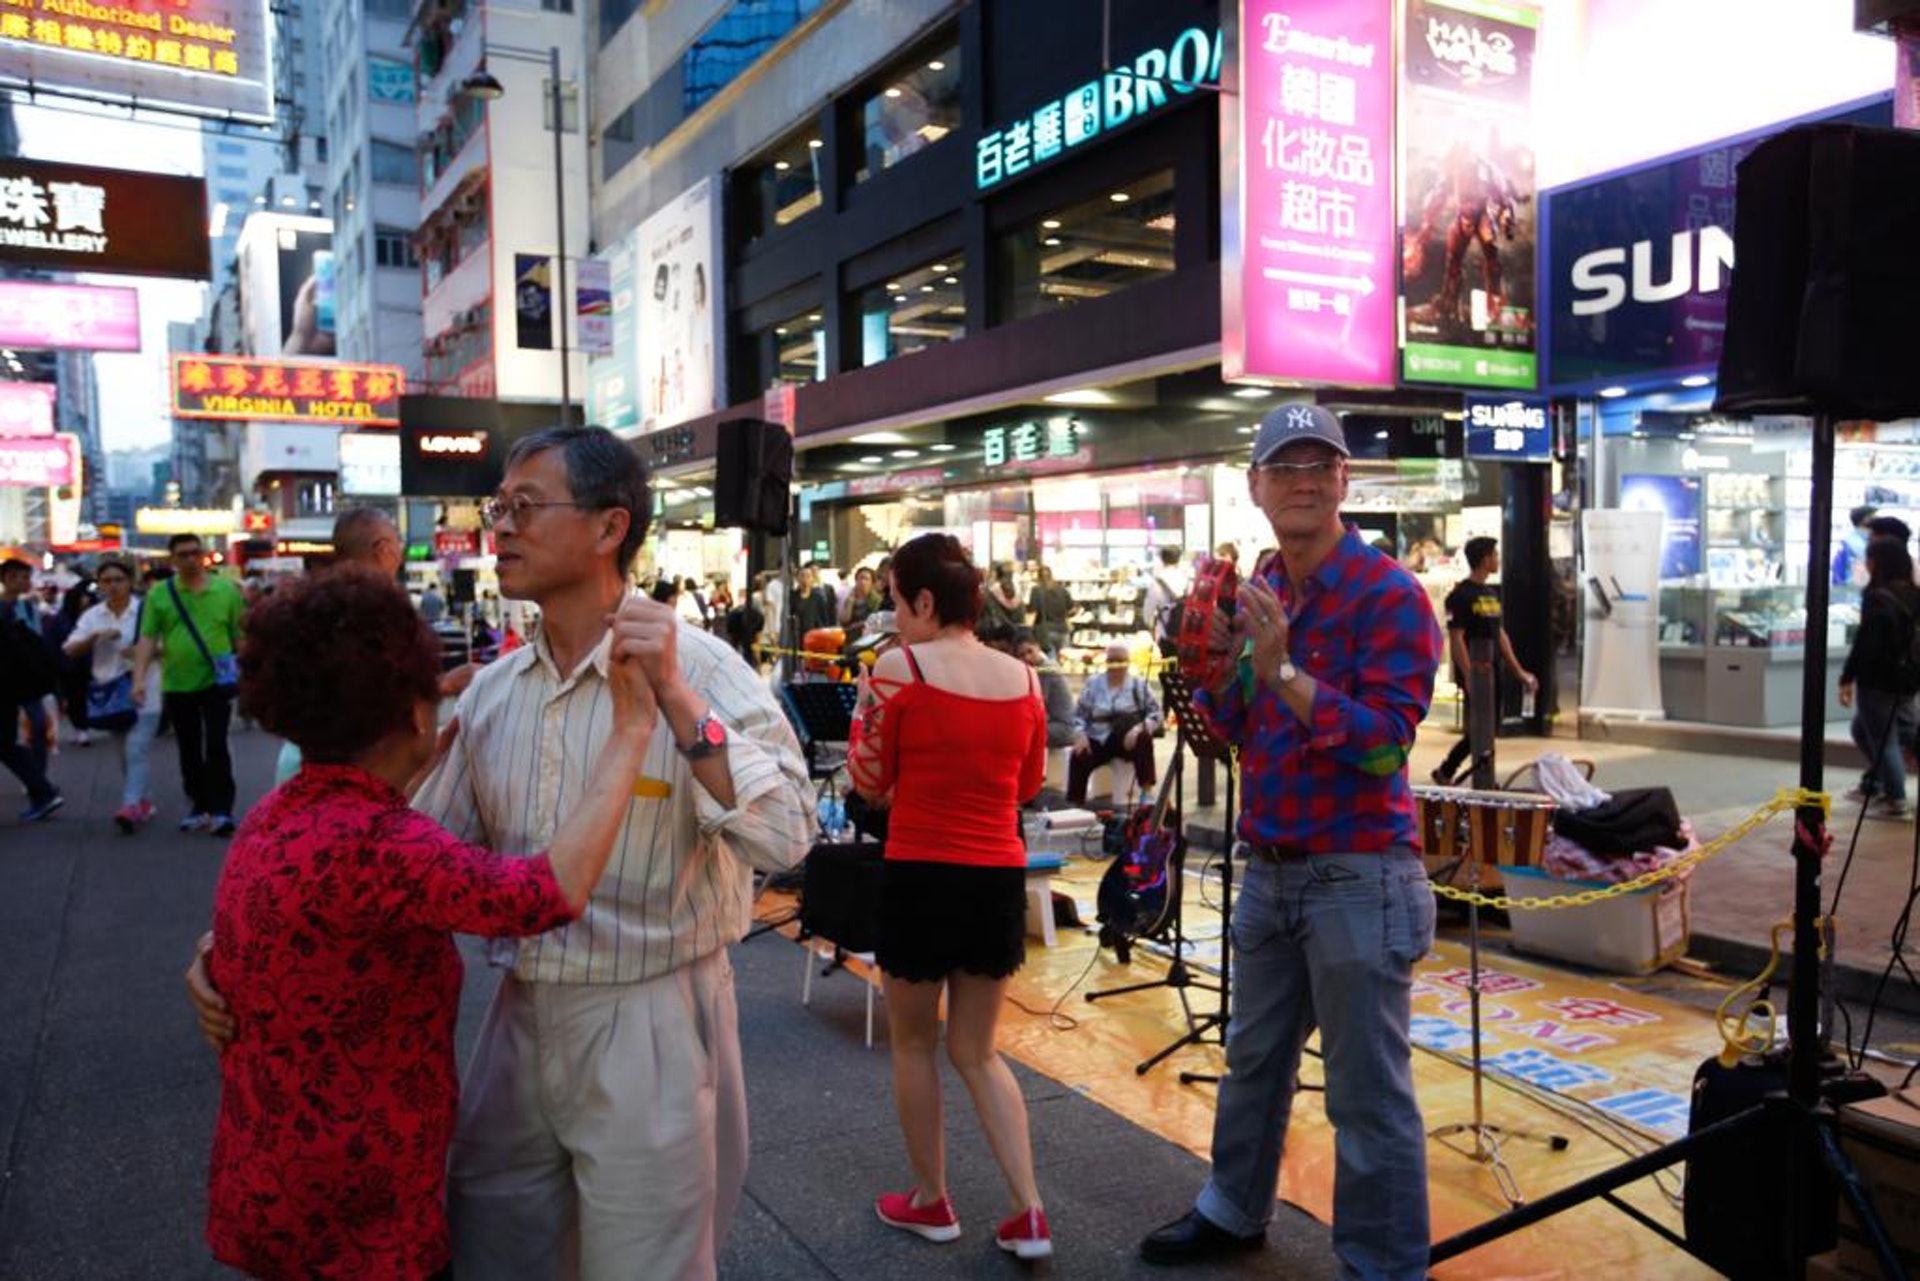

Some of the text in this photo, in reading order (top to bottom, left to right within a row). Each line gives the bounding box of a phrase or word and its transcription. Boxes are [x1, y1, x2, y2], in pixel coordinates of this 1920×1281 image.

[42, 0, 236, 44] Authorized Dealer
[1261, 118, 1375, 186] 化妝品
[1280, 179, 1357, 239] 超市
[203, 395, 376, 420] VIRGINIA HOTEL
